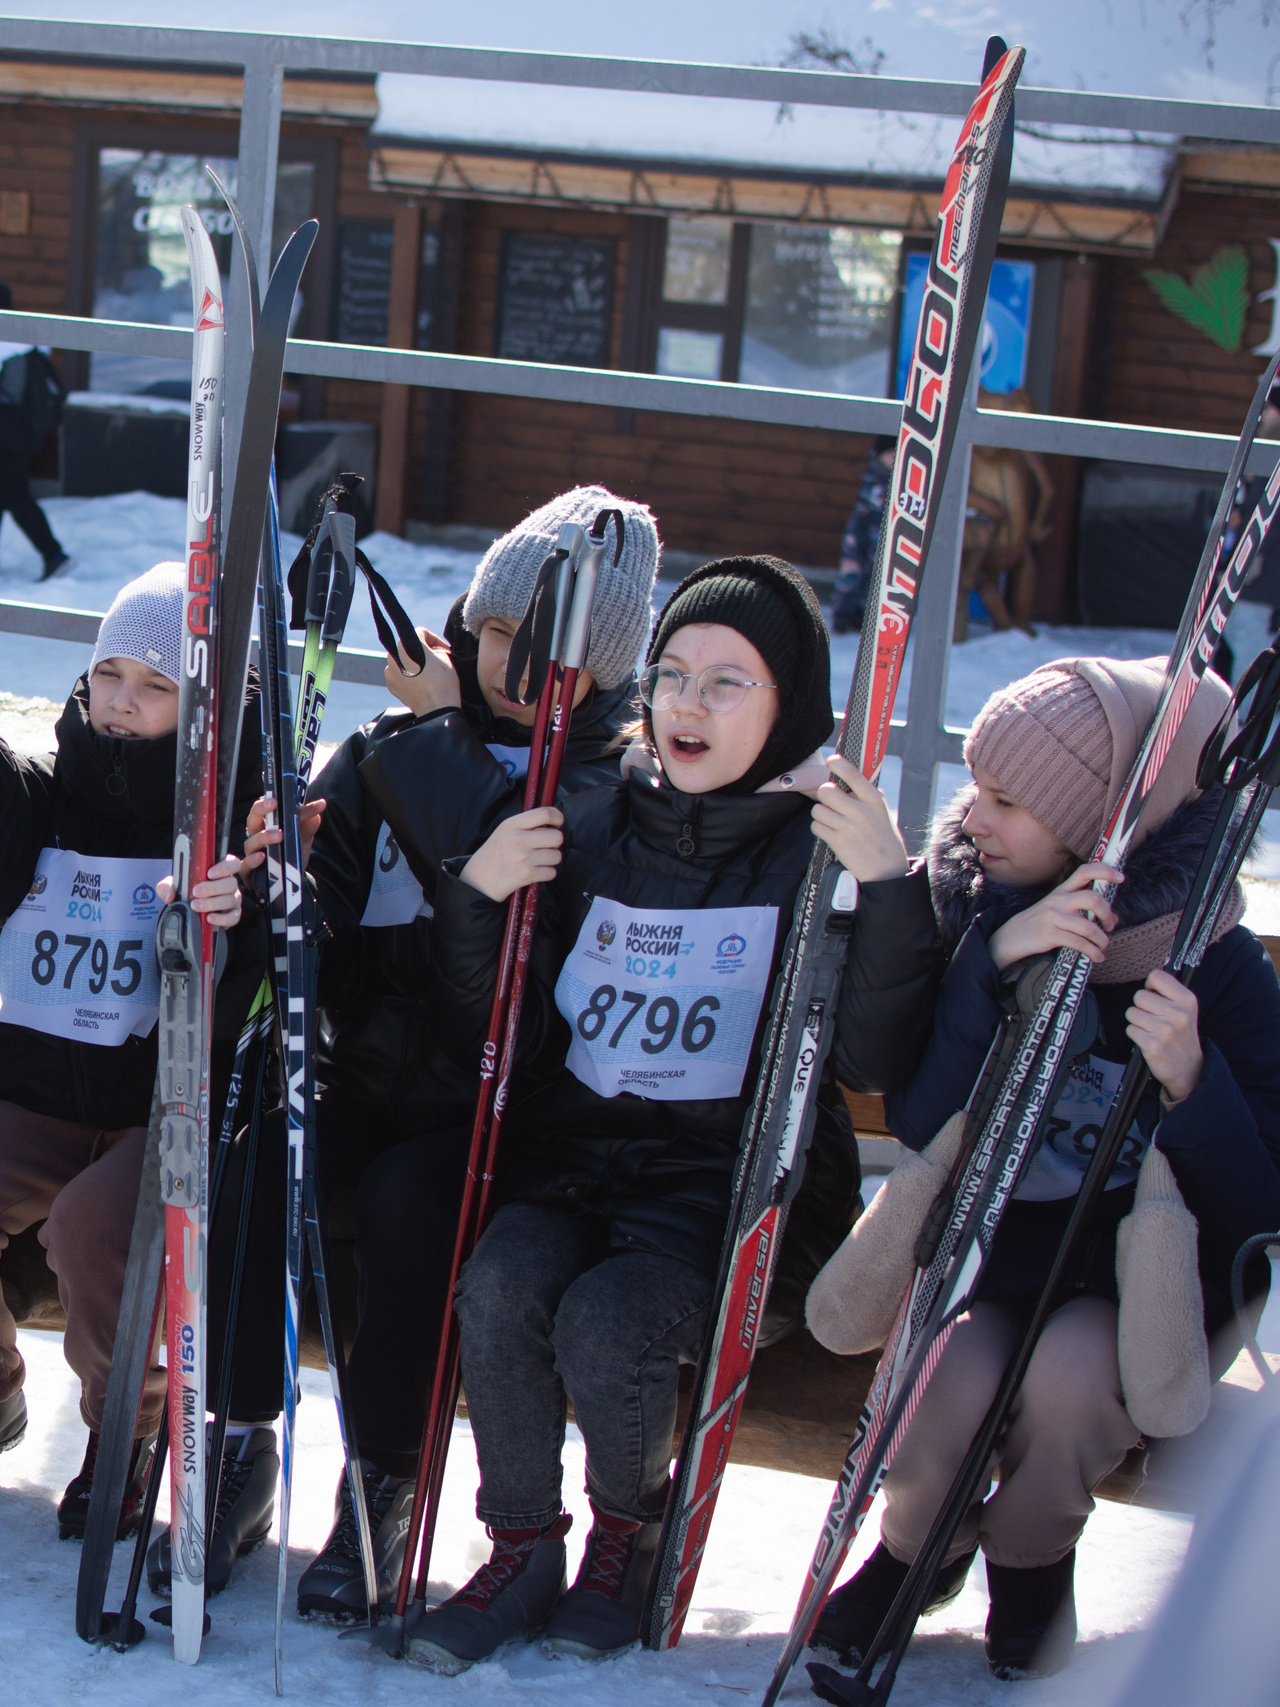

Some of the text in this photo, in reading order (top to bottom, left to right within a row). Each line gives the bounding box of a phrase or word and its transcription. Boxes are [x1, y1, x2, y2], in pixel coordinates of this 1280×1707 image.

[186, 471, 213, 687] SABLE
[868, 643, 901, 769] CLIMBING SYSTEM SUPER WAX
[625, 937, 680, 956] РОССИИ
[626, 922, 683, 940] ЛЫЖНЯ
[31, 930, 143, 996] 8795
[624, 955, 677, 979] 2024
[73, 1018, 100, 1030] ОБЛАСТЬ
[75, 1008, 120, 1020] ЧЕЛЯБИНСКАЯ
[577, 984, 720, 1054] 8796
[480, 1041, 497, 1080] 120
[620, 1069, 686, 1079] ЧЕЛЯБИНСКАЯ
[617, 1078, 660, 1089] ОБЛАСТЬ
[951, 962, 1073, 1231] WWW.SPORT-MOTOR.RU
[742, 1230, 770, 1352] universal
[182, 1325, 195, 1375] 150
